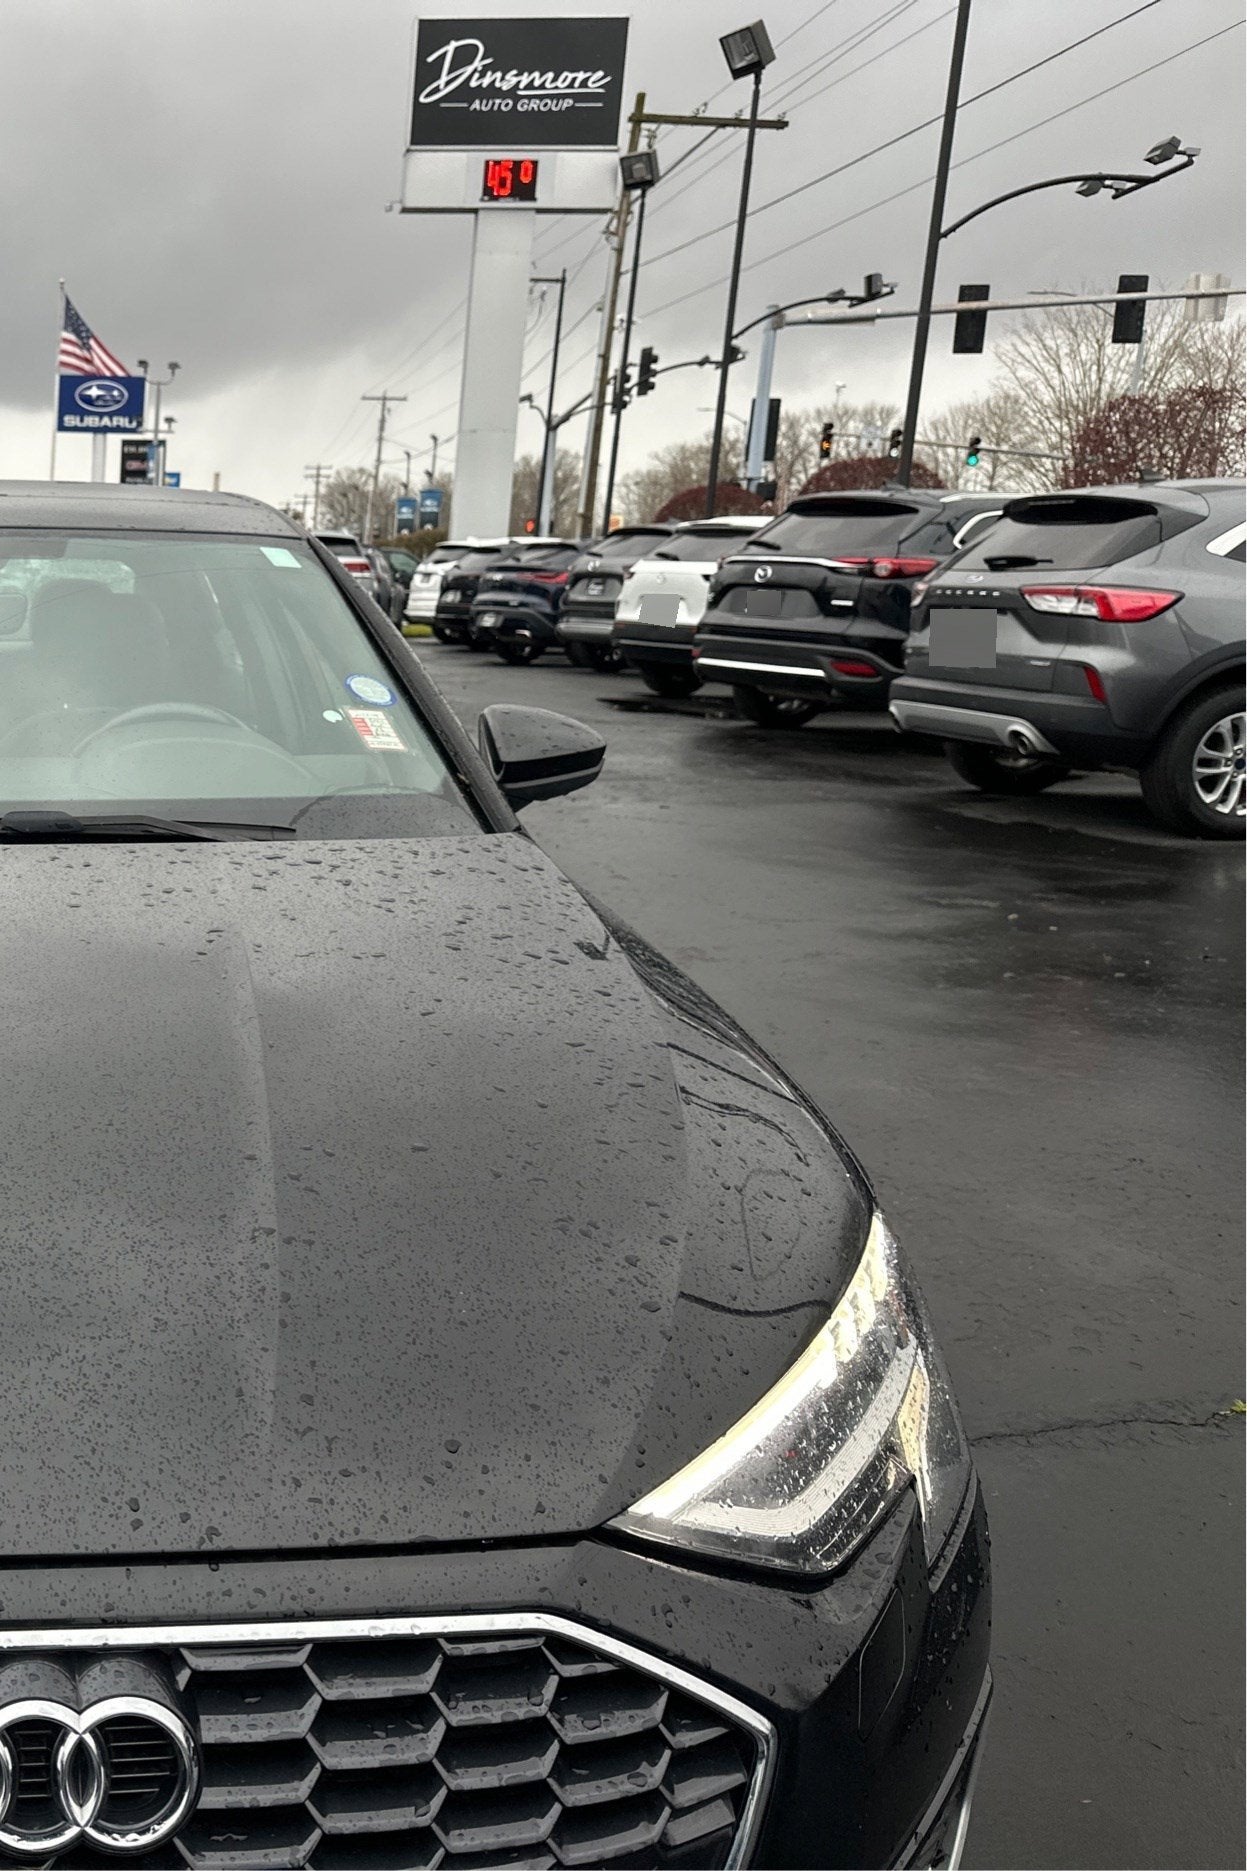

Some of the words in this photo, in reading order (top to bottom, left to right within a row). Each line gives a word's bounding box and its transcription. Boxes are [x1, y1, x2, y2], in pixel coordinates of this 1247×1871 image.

[419, 38, 613, 104] Dinsmore
[469, 98, 513, 112] AUTO
[516, 98, 574, 112] GROUP
[63, 414, 137, 429] SUBARU
